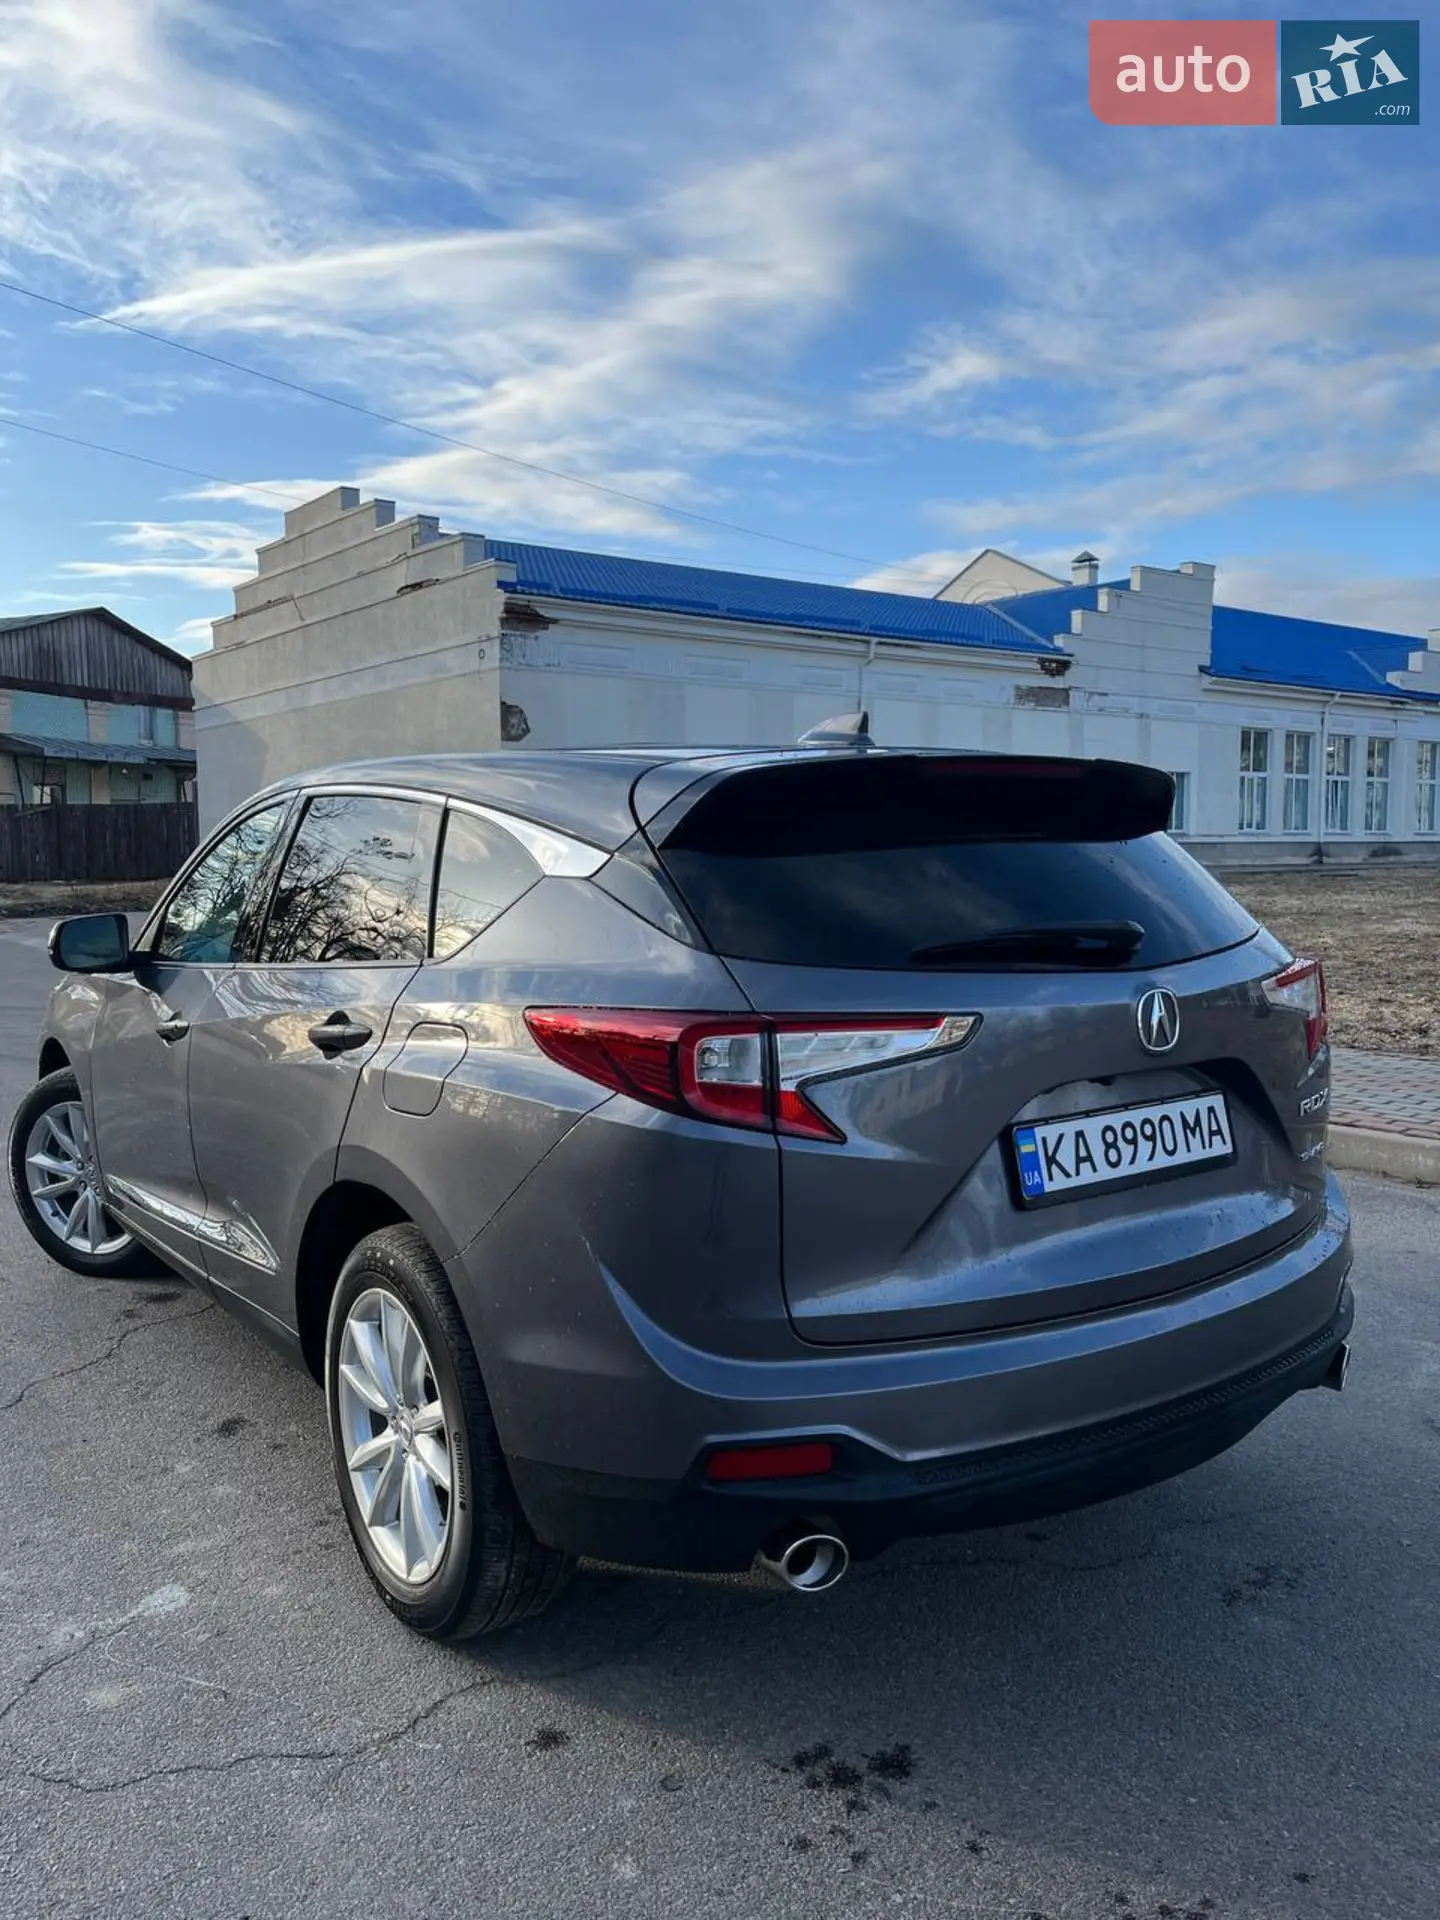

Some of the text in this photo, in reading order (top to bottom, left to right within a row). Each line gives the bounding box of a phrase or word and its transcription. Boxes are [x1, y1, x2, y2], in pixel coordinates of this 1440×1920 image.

[1041, 1105, 1227, 1182] KA 8990 MA
[1024, 1170, 1042, 1186] UA
